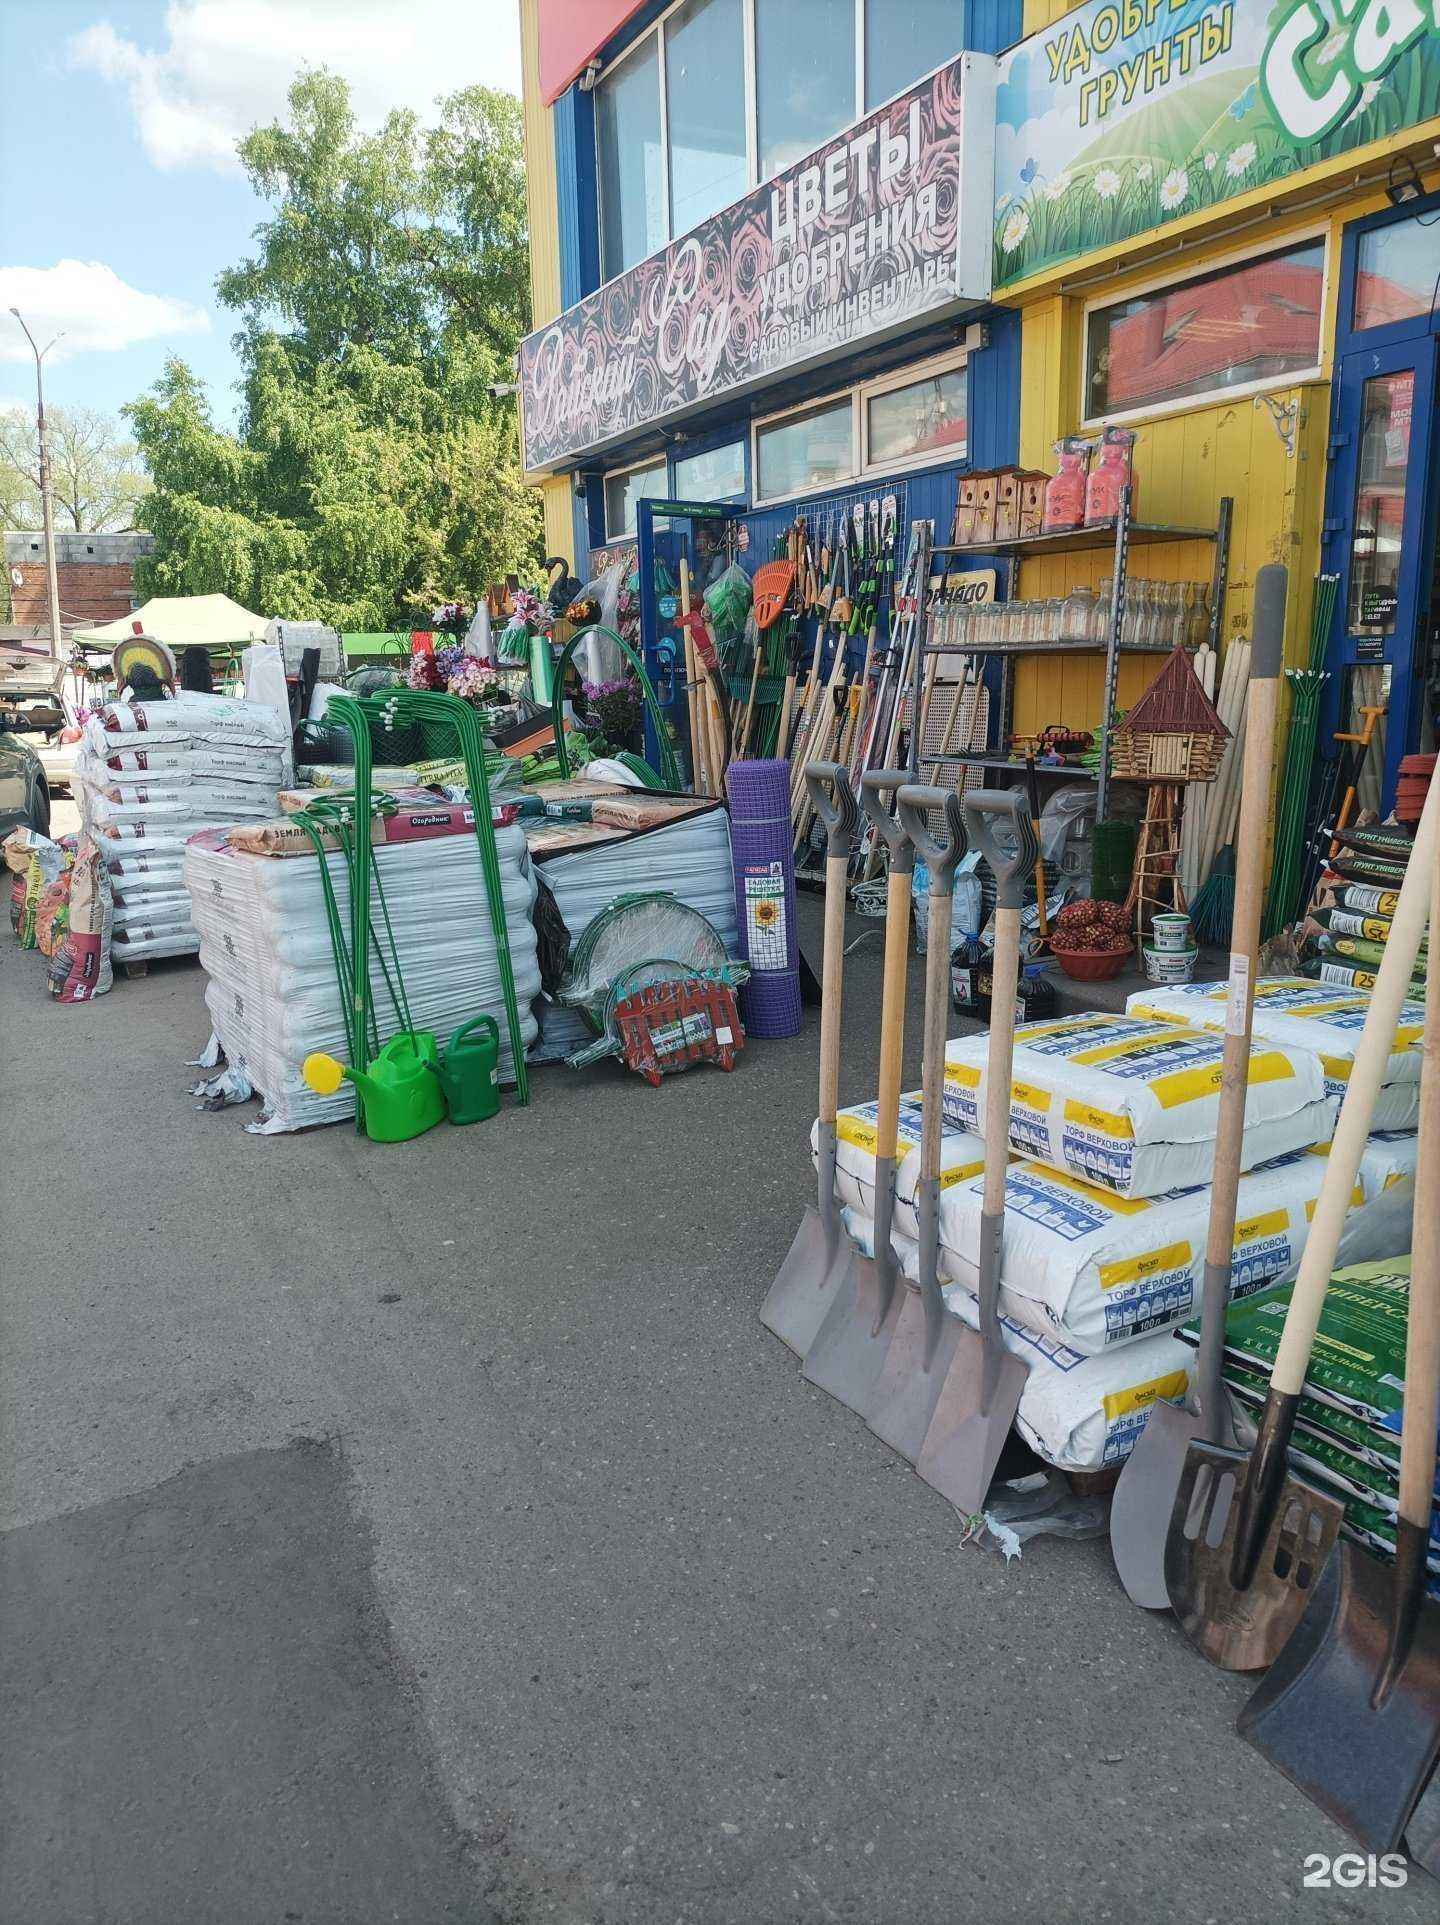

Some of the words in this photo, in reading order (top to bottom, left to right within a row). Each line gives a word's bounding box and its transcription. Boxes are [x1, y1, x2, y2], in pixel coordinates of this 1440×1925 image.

[1045, 0, 1188, 85] УДОБР
[1079, 2, 1234, 128] ГРУНТЫ
[1260, 0, 1440, 147] Са
[771, 98, 921, 246] ЦВЕТЫ
[758, 182, 937, 313] УДОБРЕНИЯ
[648, 238, 731, 393] Сад
[749, 304, 829, 363] САДОВЫЙ
[831, 254, 951, 328] ИНВЕНТАРЬ
[274, 828, 306, 839] ЗЕМЛЯ
[411, 815, 450, 826] Огородник
[1355, 831, 1378, 842] ГРУНТ
[1352, 861, 1375, 870] ГРУНТ
[1375, 864, 1408, 875] УНИВЕРС
[1358, 973, 1375, 988] 25
[944, 1084, 976, 1100] ЕРХОВОЙ
[1065, 1125, 1086, 1139] ТОРФ
[1008, 1171, 1042, 1187] ТОРФ
[1041, 1185, 1114, 1222] ВЕРХОВОЙ
[1240, 1234, 1288, 1257] ВЕРХОВОЙ
[1106, 1287, 1137, 1302] ТОРФ
[1139, 1267, 1191, 1294] ВЕРХОВОЙ
[1108, 1417, 1134, 1434] ТОРФ
